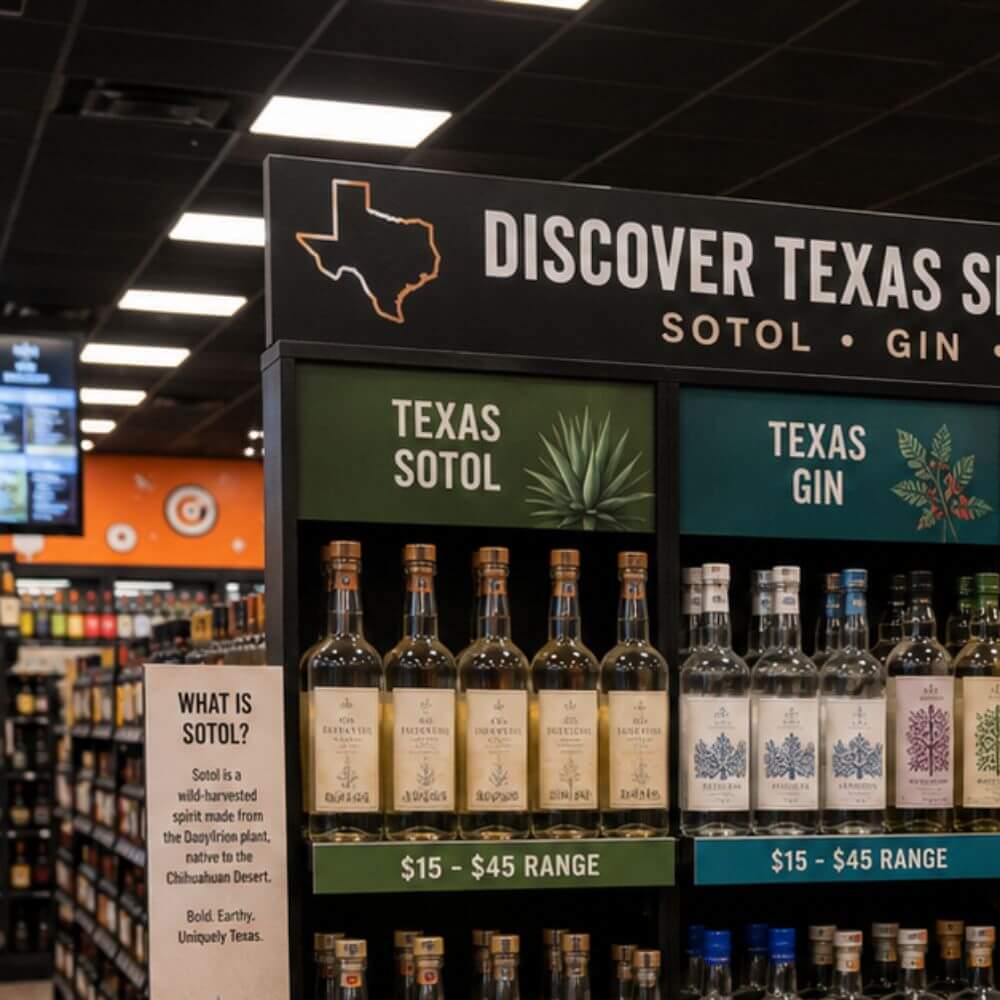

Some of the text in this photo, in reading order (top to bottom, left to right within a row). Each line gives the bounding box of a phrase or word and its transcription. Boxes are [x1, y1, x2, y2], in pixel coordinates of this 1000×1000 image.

[483, 208, 755, 297] DISCOVER
[775, 236, 942, 311] TEXAS
[661, 311, 812, 353] SOTOL
[886, 328, 960, 362] GIN
[392, 399, 501, 442] TEXAS
[769, 420, 866, 461] TEXAS
[393, 449, 501, 492] SOTOL
[792, 468, 844, 505] GIN
[178, 692, 252, 714] WHAT IS
[183, 723, 249, 744] SOTOL?
[192, 769, 241, 782] Sotol is a
[178, 790, 256, 802] wild-harvested
[173, 810, 263, 823] spirit made from
[164, 832, 181, 843] the
[186, 852, 253, 864] native to the
[401, 853, 600, 881] $15 $45 RANGE
[771, 848, 948, 872] $15 $45 RANGE
[234, 871, 271, 883] Desert.
[186, 910, 255, 923] Bold. Earthy.
[178, 929, 263, 945] Uniquely Texas.
